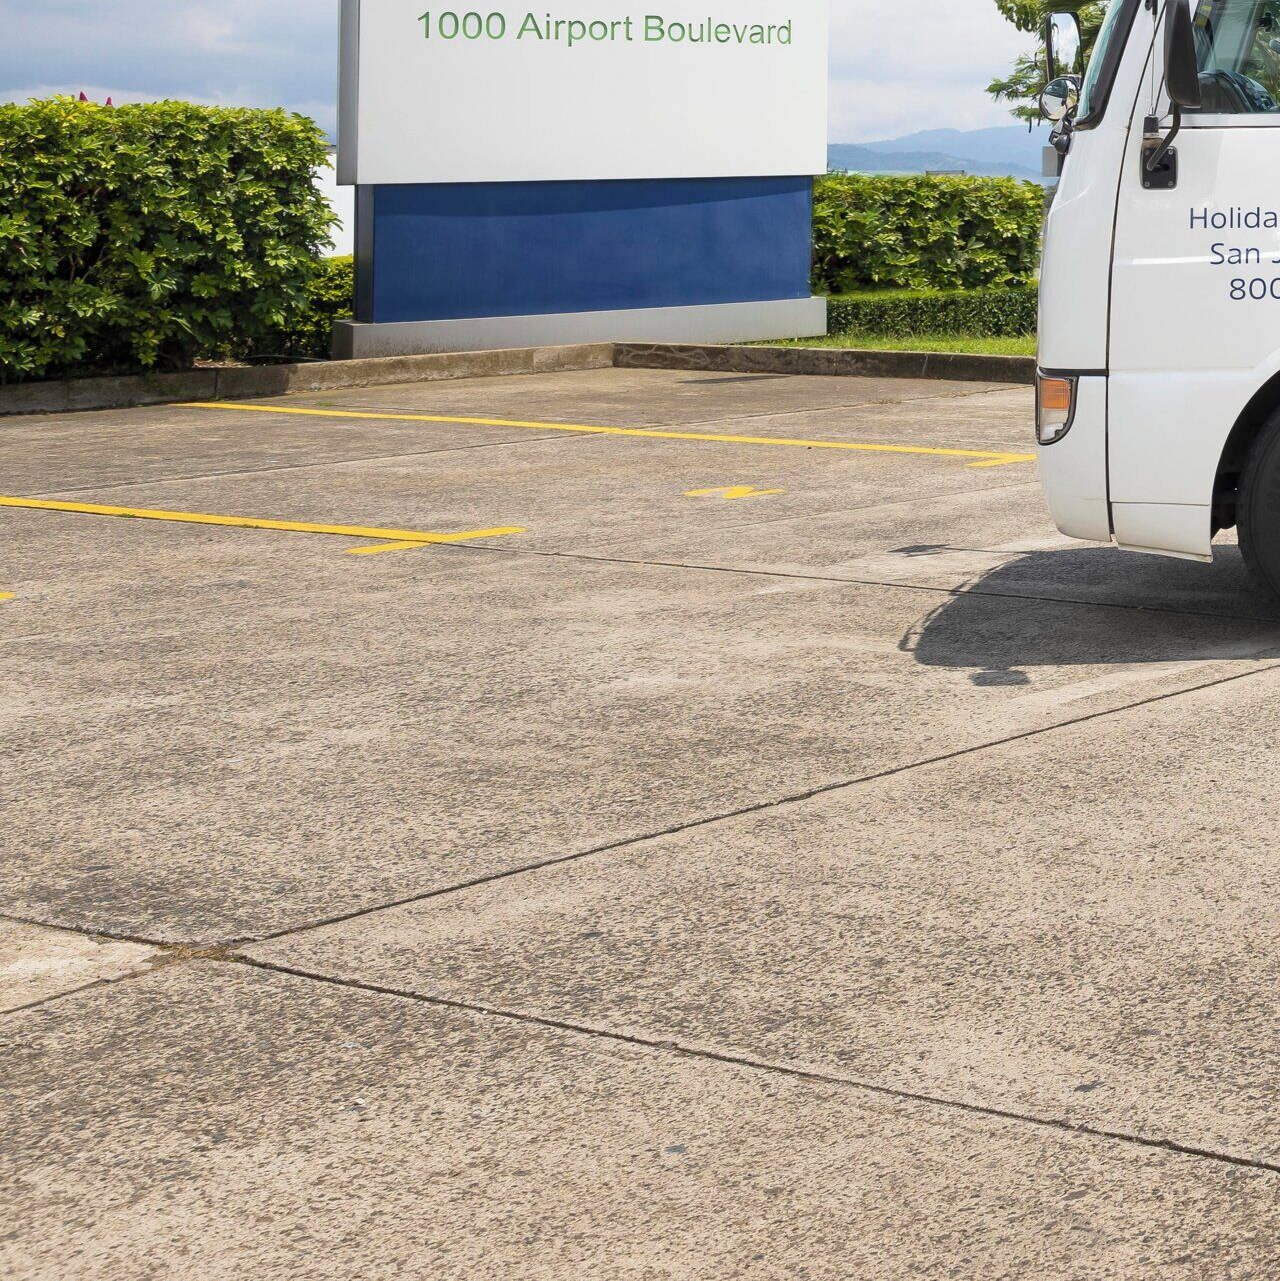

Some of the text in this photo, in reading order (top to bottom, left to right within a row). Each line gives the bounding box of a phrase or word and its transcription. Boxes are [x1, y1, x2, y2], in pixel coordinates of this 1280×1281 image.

[417, 11, 792, 47] 1000 Airport Boulevard
[1209, 242, 1261, 265] San
